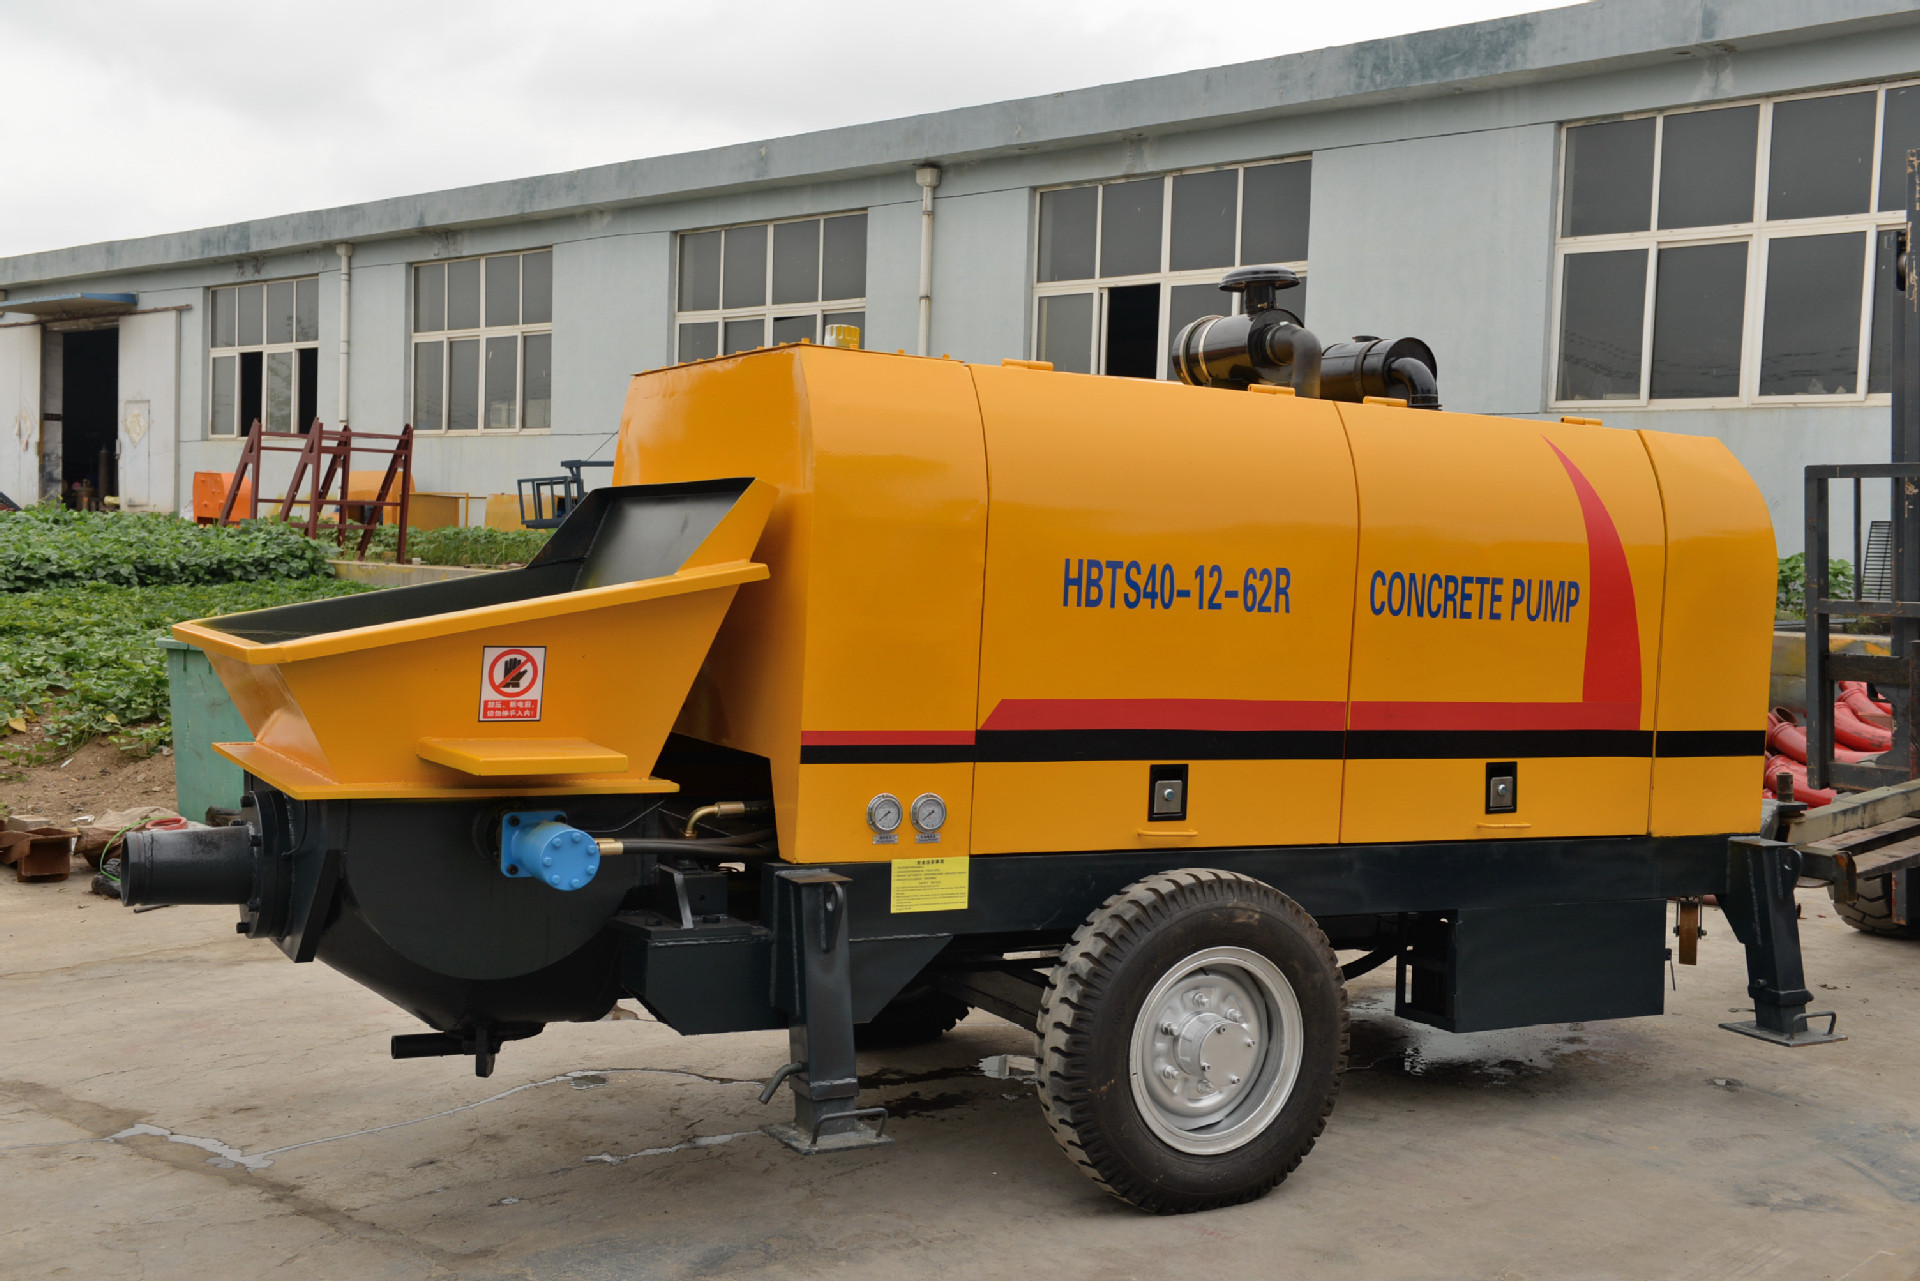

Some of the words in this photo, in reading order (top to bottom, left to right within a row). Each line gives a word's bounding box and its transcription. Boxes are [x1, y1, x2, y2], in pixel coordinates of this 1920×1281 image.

[1063, 558, 1291, 613] HBTS40-12-62R
[1370, 569, 1504, 621] CONCRETE
[1510, 578, 1580, 623] PUMP
